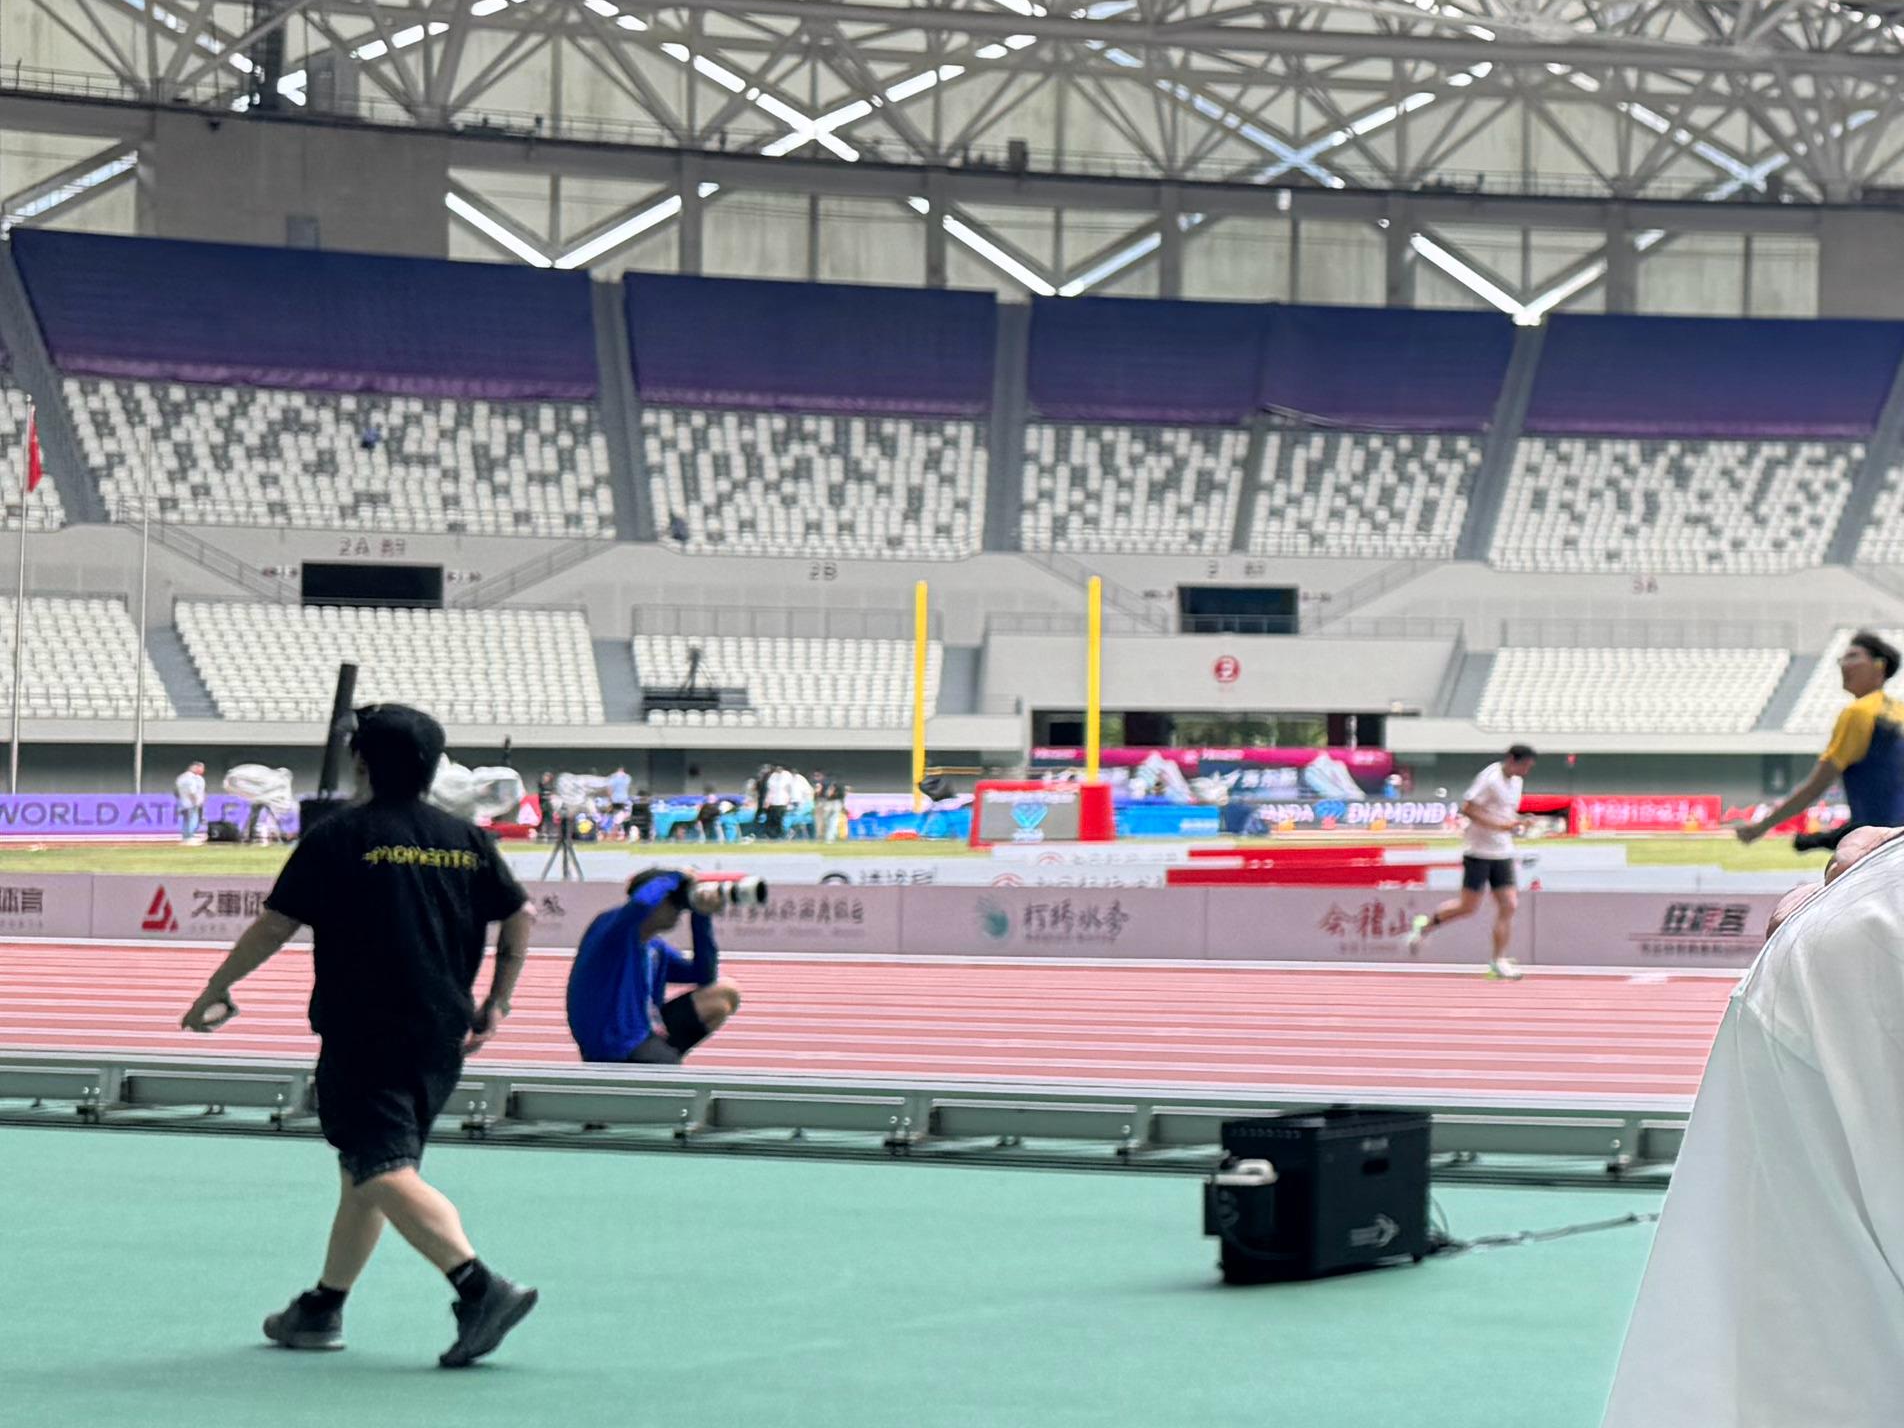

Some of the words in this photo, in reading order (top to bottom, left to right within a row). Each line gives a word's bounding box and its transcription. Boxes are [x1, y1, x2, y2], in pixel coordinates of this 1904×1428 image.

[0, 801, 119, 825] WORLD
[191, 889, 266, 917] 久事体
